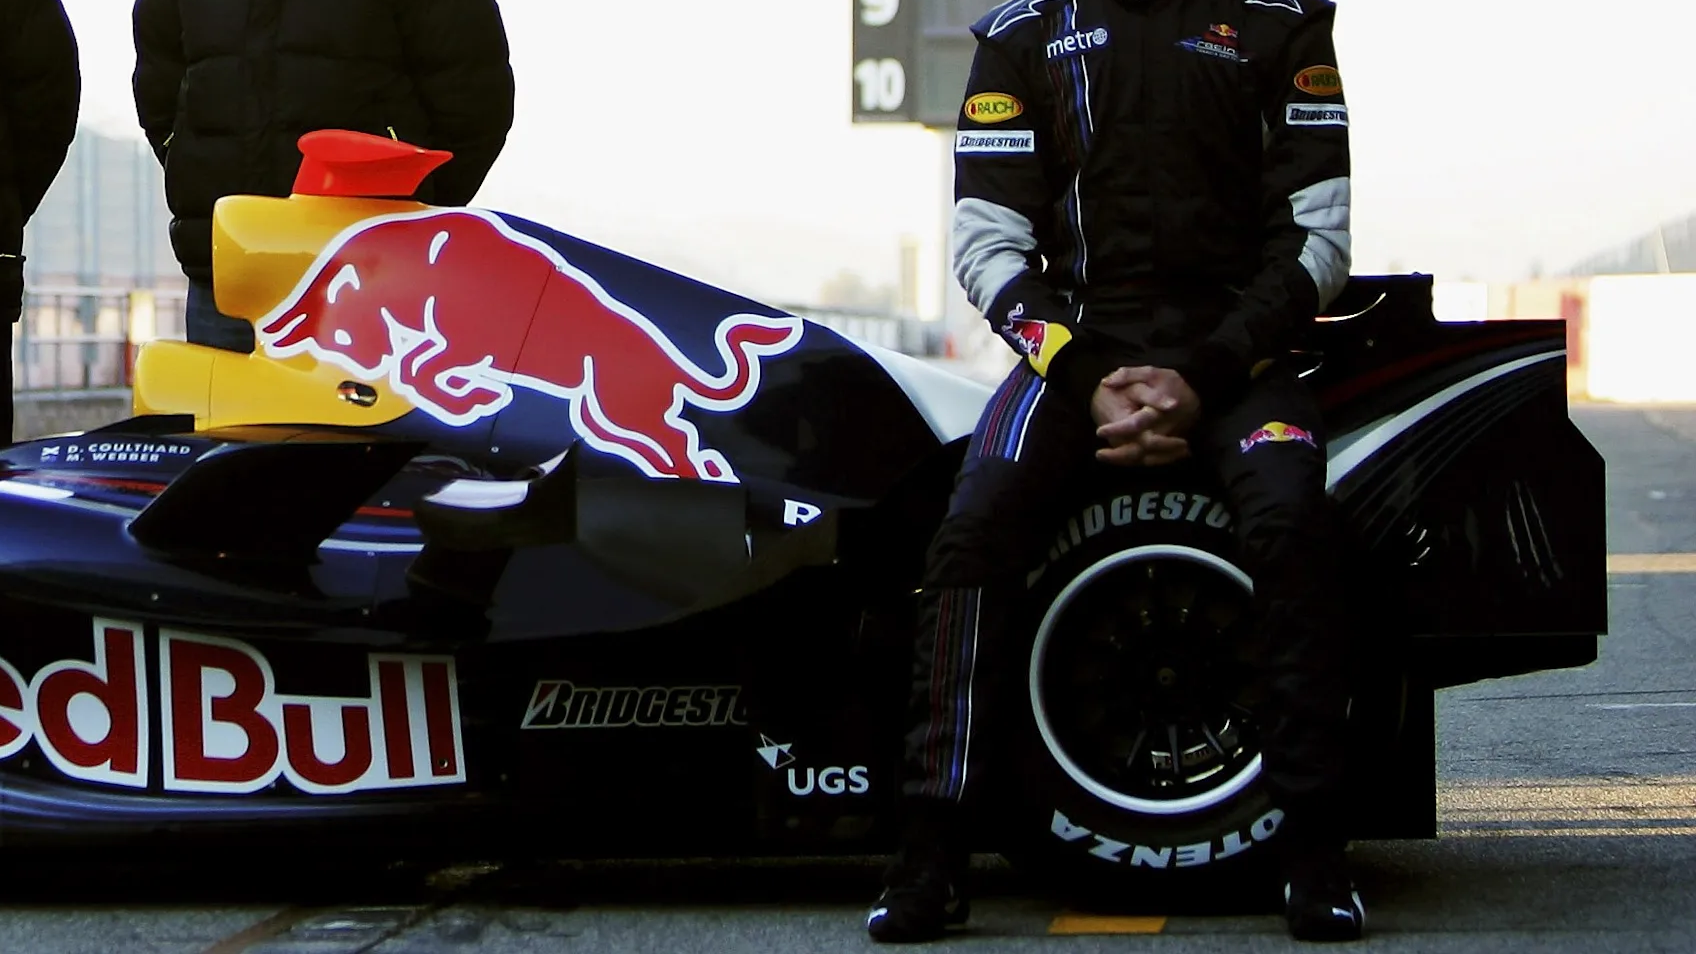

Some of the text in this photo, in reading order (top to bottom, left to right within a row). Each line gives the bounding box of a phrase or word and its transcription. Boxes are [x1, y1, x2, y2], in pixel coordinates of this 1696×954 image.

[1047, 27, 1107, 59] metro
[855, 58, 905, 111] 10
[977, 101, 1015, 115] RAUCH
[959, 135, 1032, 148] BRIDGESTONE
[67, 443, 192, 455] D. COULTHARD
[92, 453, 161, 462] WEBBER
[788, 765, 870, 796] UGS
[1050, 808, 1286, 869] OTENZA
